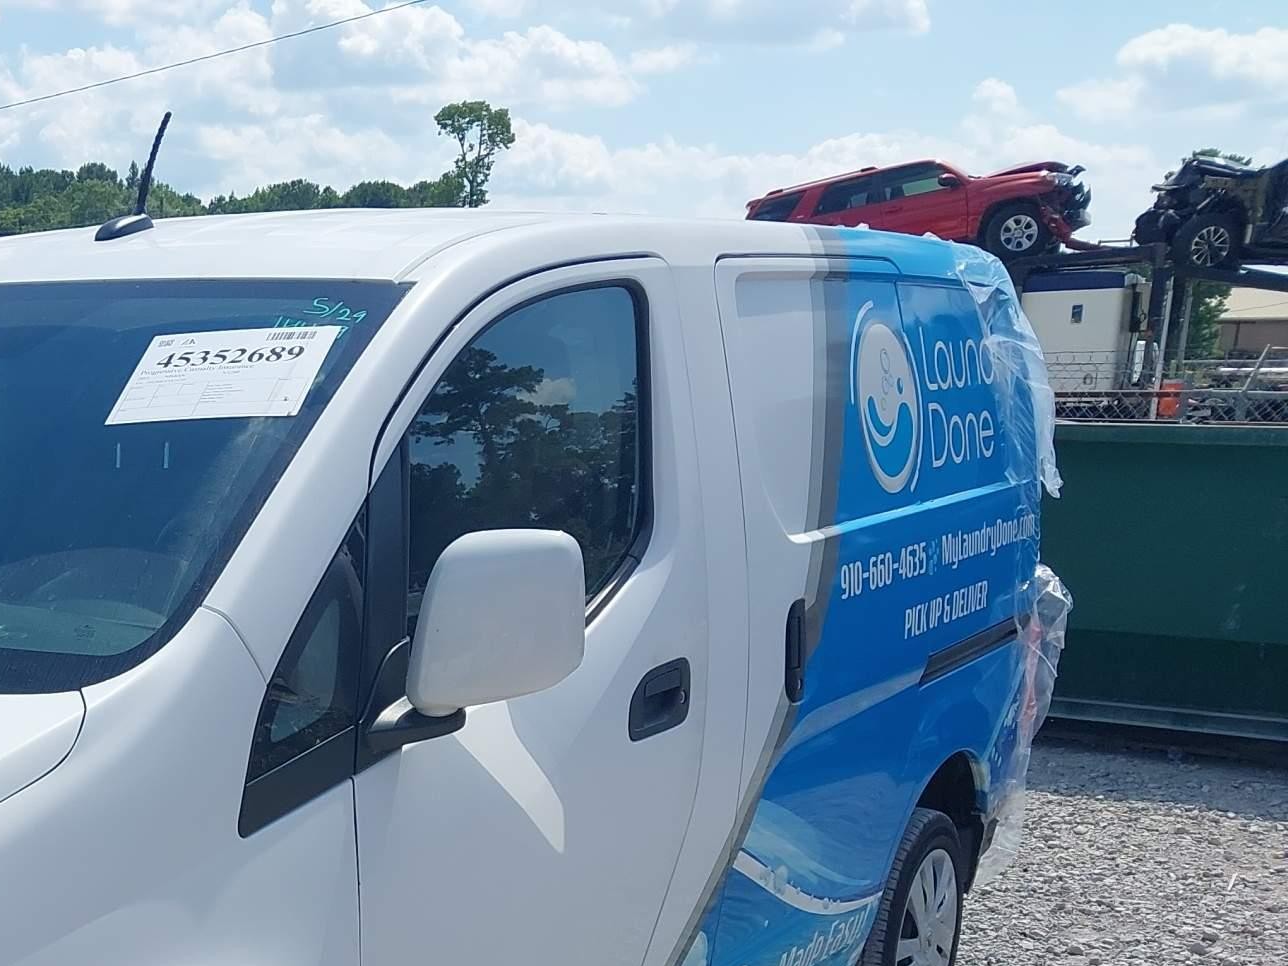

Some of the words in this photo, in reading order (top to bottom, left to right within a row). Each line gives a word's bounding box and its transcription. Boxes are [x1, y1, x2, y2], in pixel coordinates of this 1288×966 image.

[156, 345, 305, 368] 45352689
[928, 402, 995, 468] Done
[841, 541, 927, 600] 910-660-4635
[942, 513, 1036, 569] MyLaundryDone.com
[904, 602, 929, 640] PICK
[929, 597, 943, 629] UP
[943, 593, 951, 624] &
[951, 580, 989, 621] DELIVER
